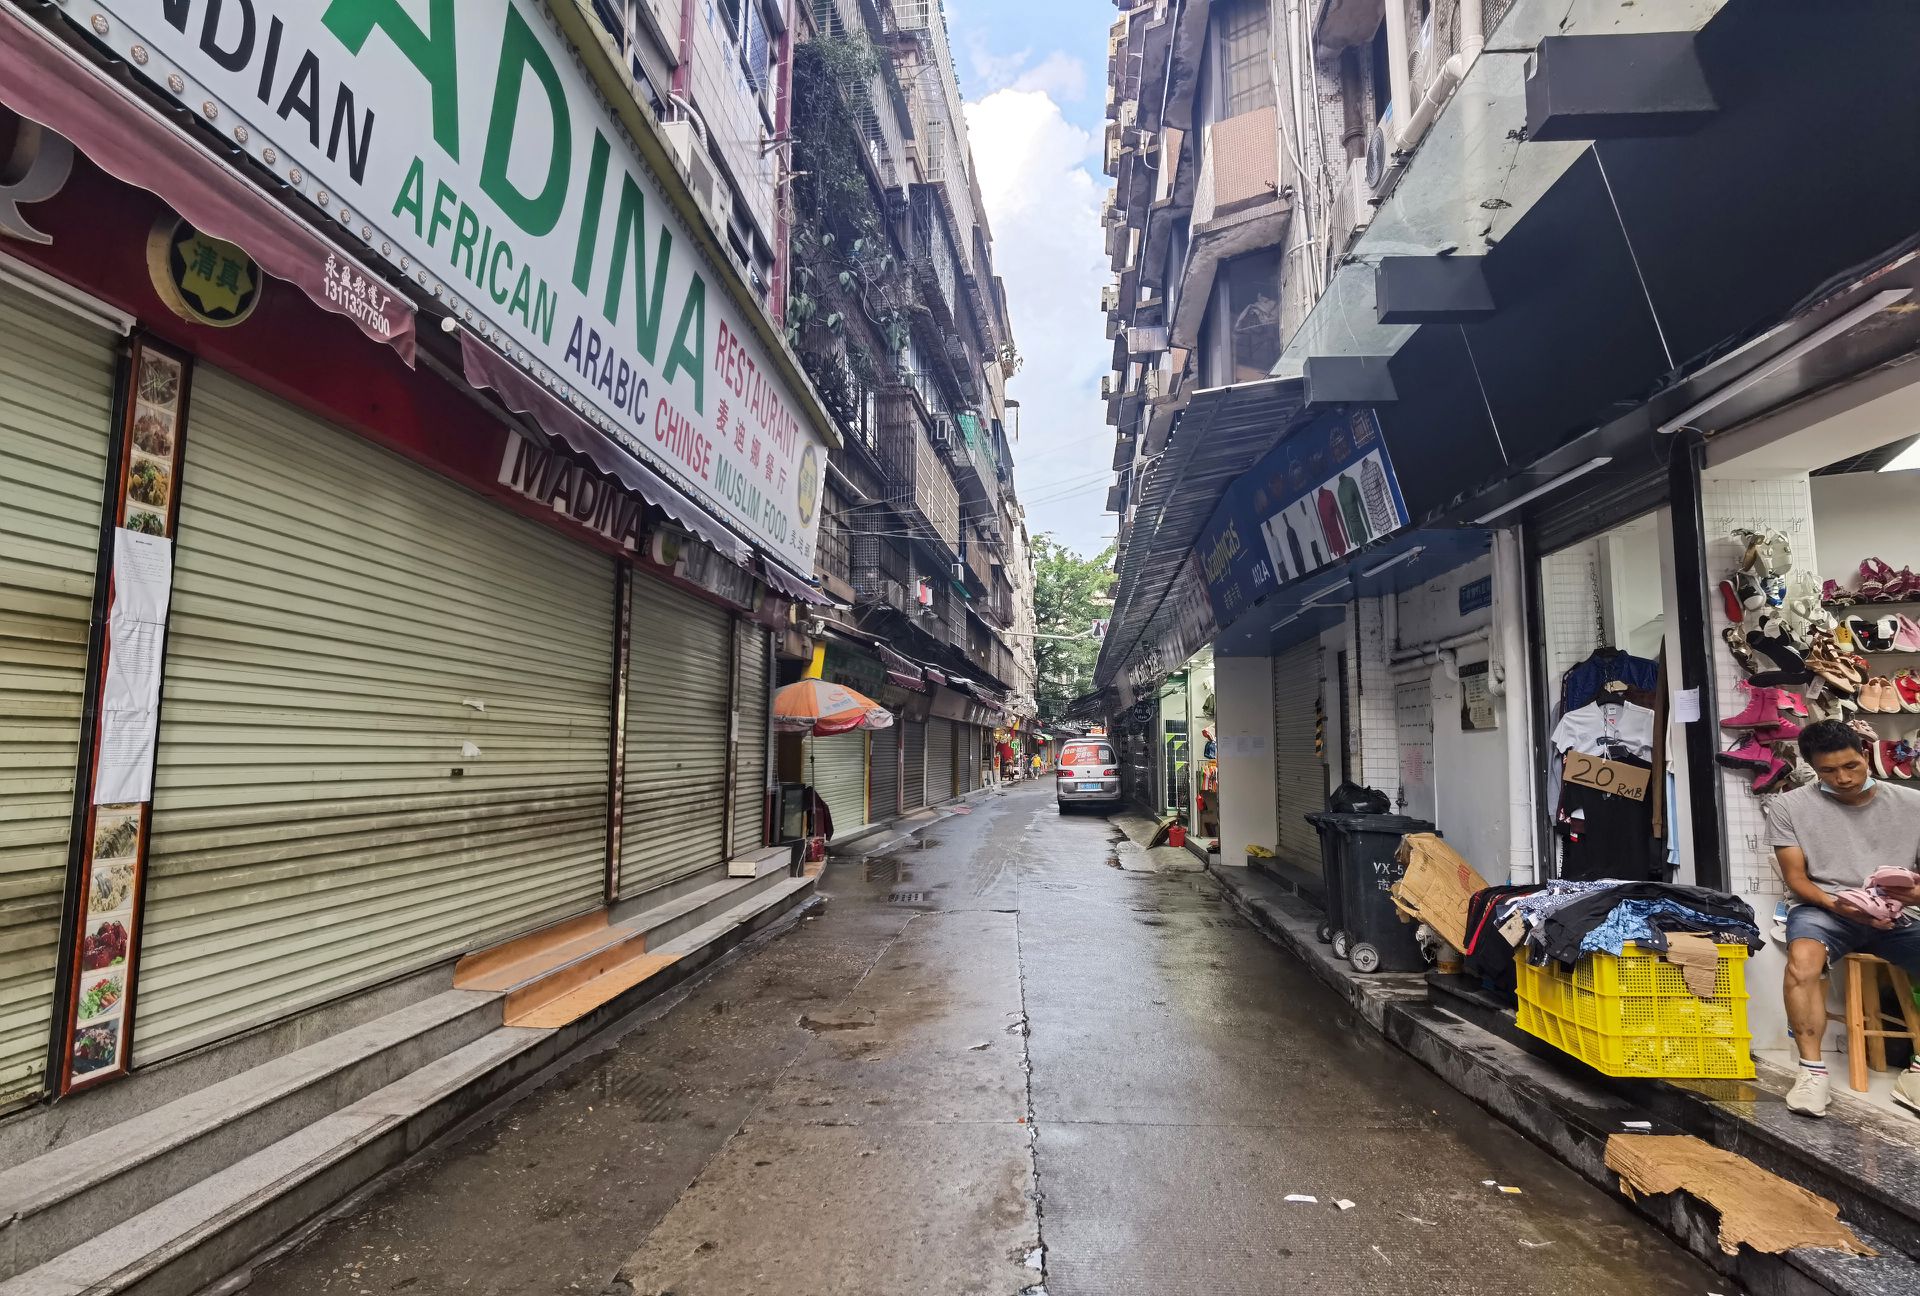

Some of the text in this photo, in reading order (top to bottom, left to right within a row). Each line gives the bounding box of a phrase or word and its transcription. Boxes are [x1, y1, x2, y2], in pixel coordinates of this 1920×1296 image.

[190, 241, 243, 295] 清真
[323, 276, 390, 337] 13113377500
[392, 156, 558, 346] AFRICAN
[564, 315, 649, 425] ARABIC
[655, 398, 712, 481] CHINSE
[714, 453, 761, 522] MUSLIM
[762, 500, 788, 545] FOOD
[715, 318, 799, 464] RESTAURANT
[505, 432, 642, 552] MADINA
[1571, 758, 1642, 799] 20 RMB
